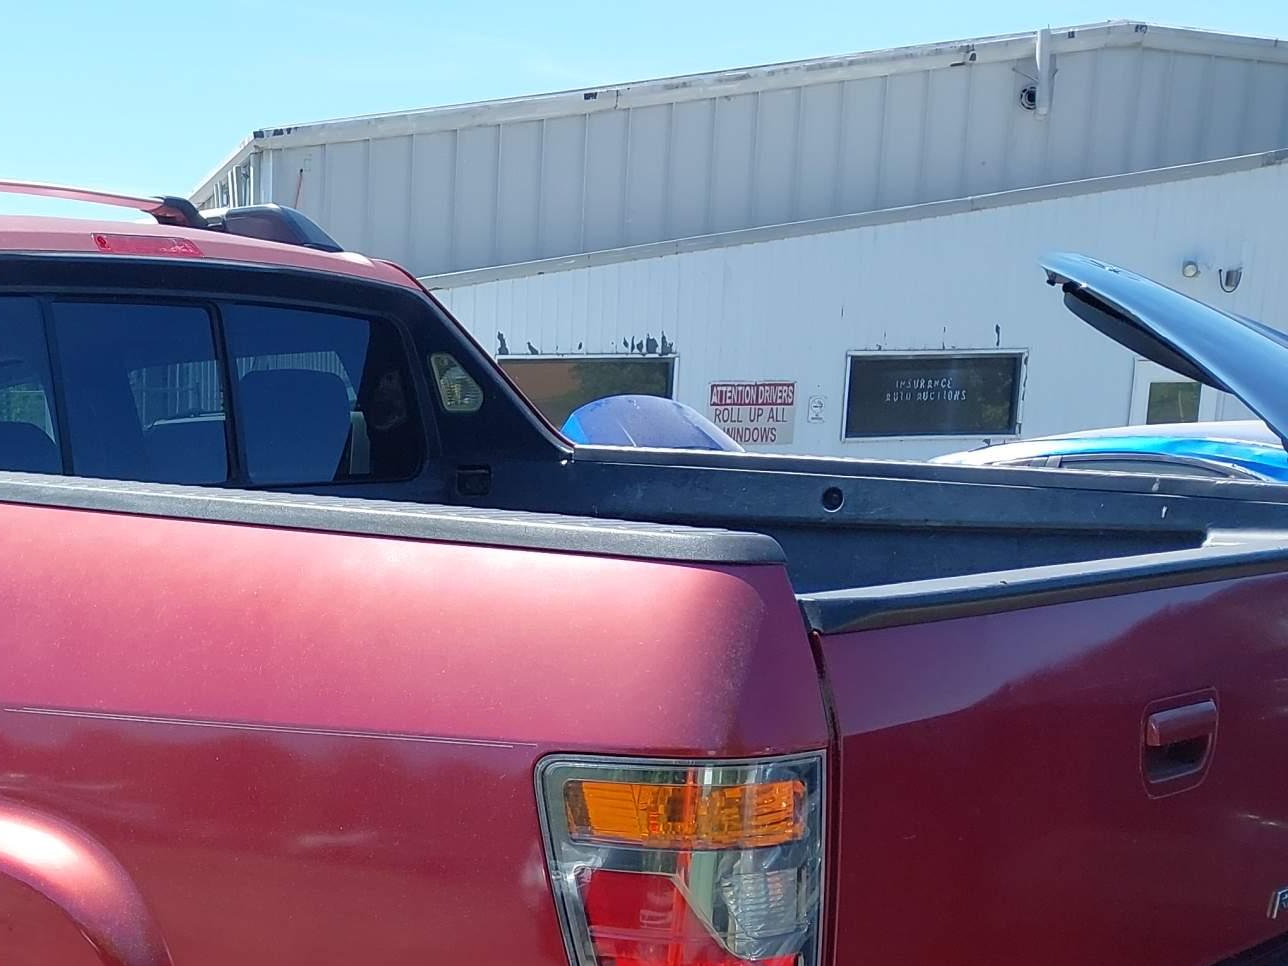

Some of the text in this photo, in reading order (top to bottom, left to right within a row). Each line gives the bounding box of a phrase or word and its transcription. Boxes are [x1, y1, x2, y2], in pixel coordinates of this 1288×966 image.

[895, 377, 953, 389] INSURANCE
[711, 384, 794, 404] ATTENTION DRIVERS
[885, 390, 967, 402] AUTO AUCTIONS
[713, 407, 788, 423] ROLL UP ALL
